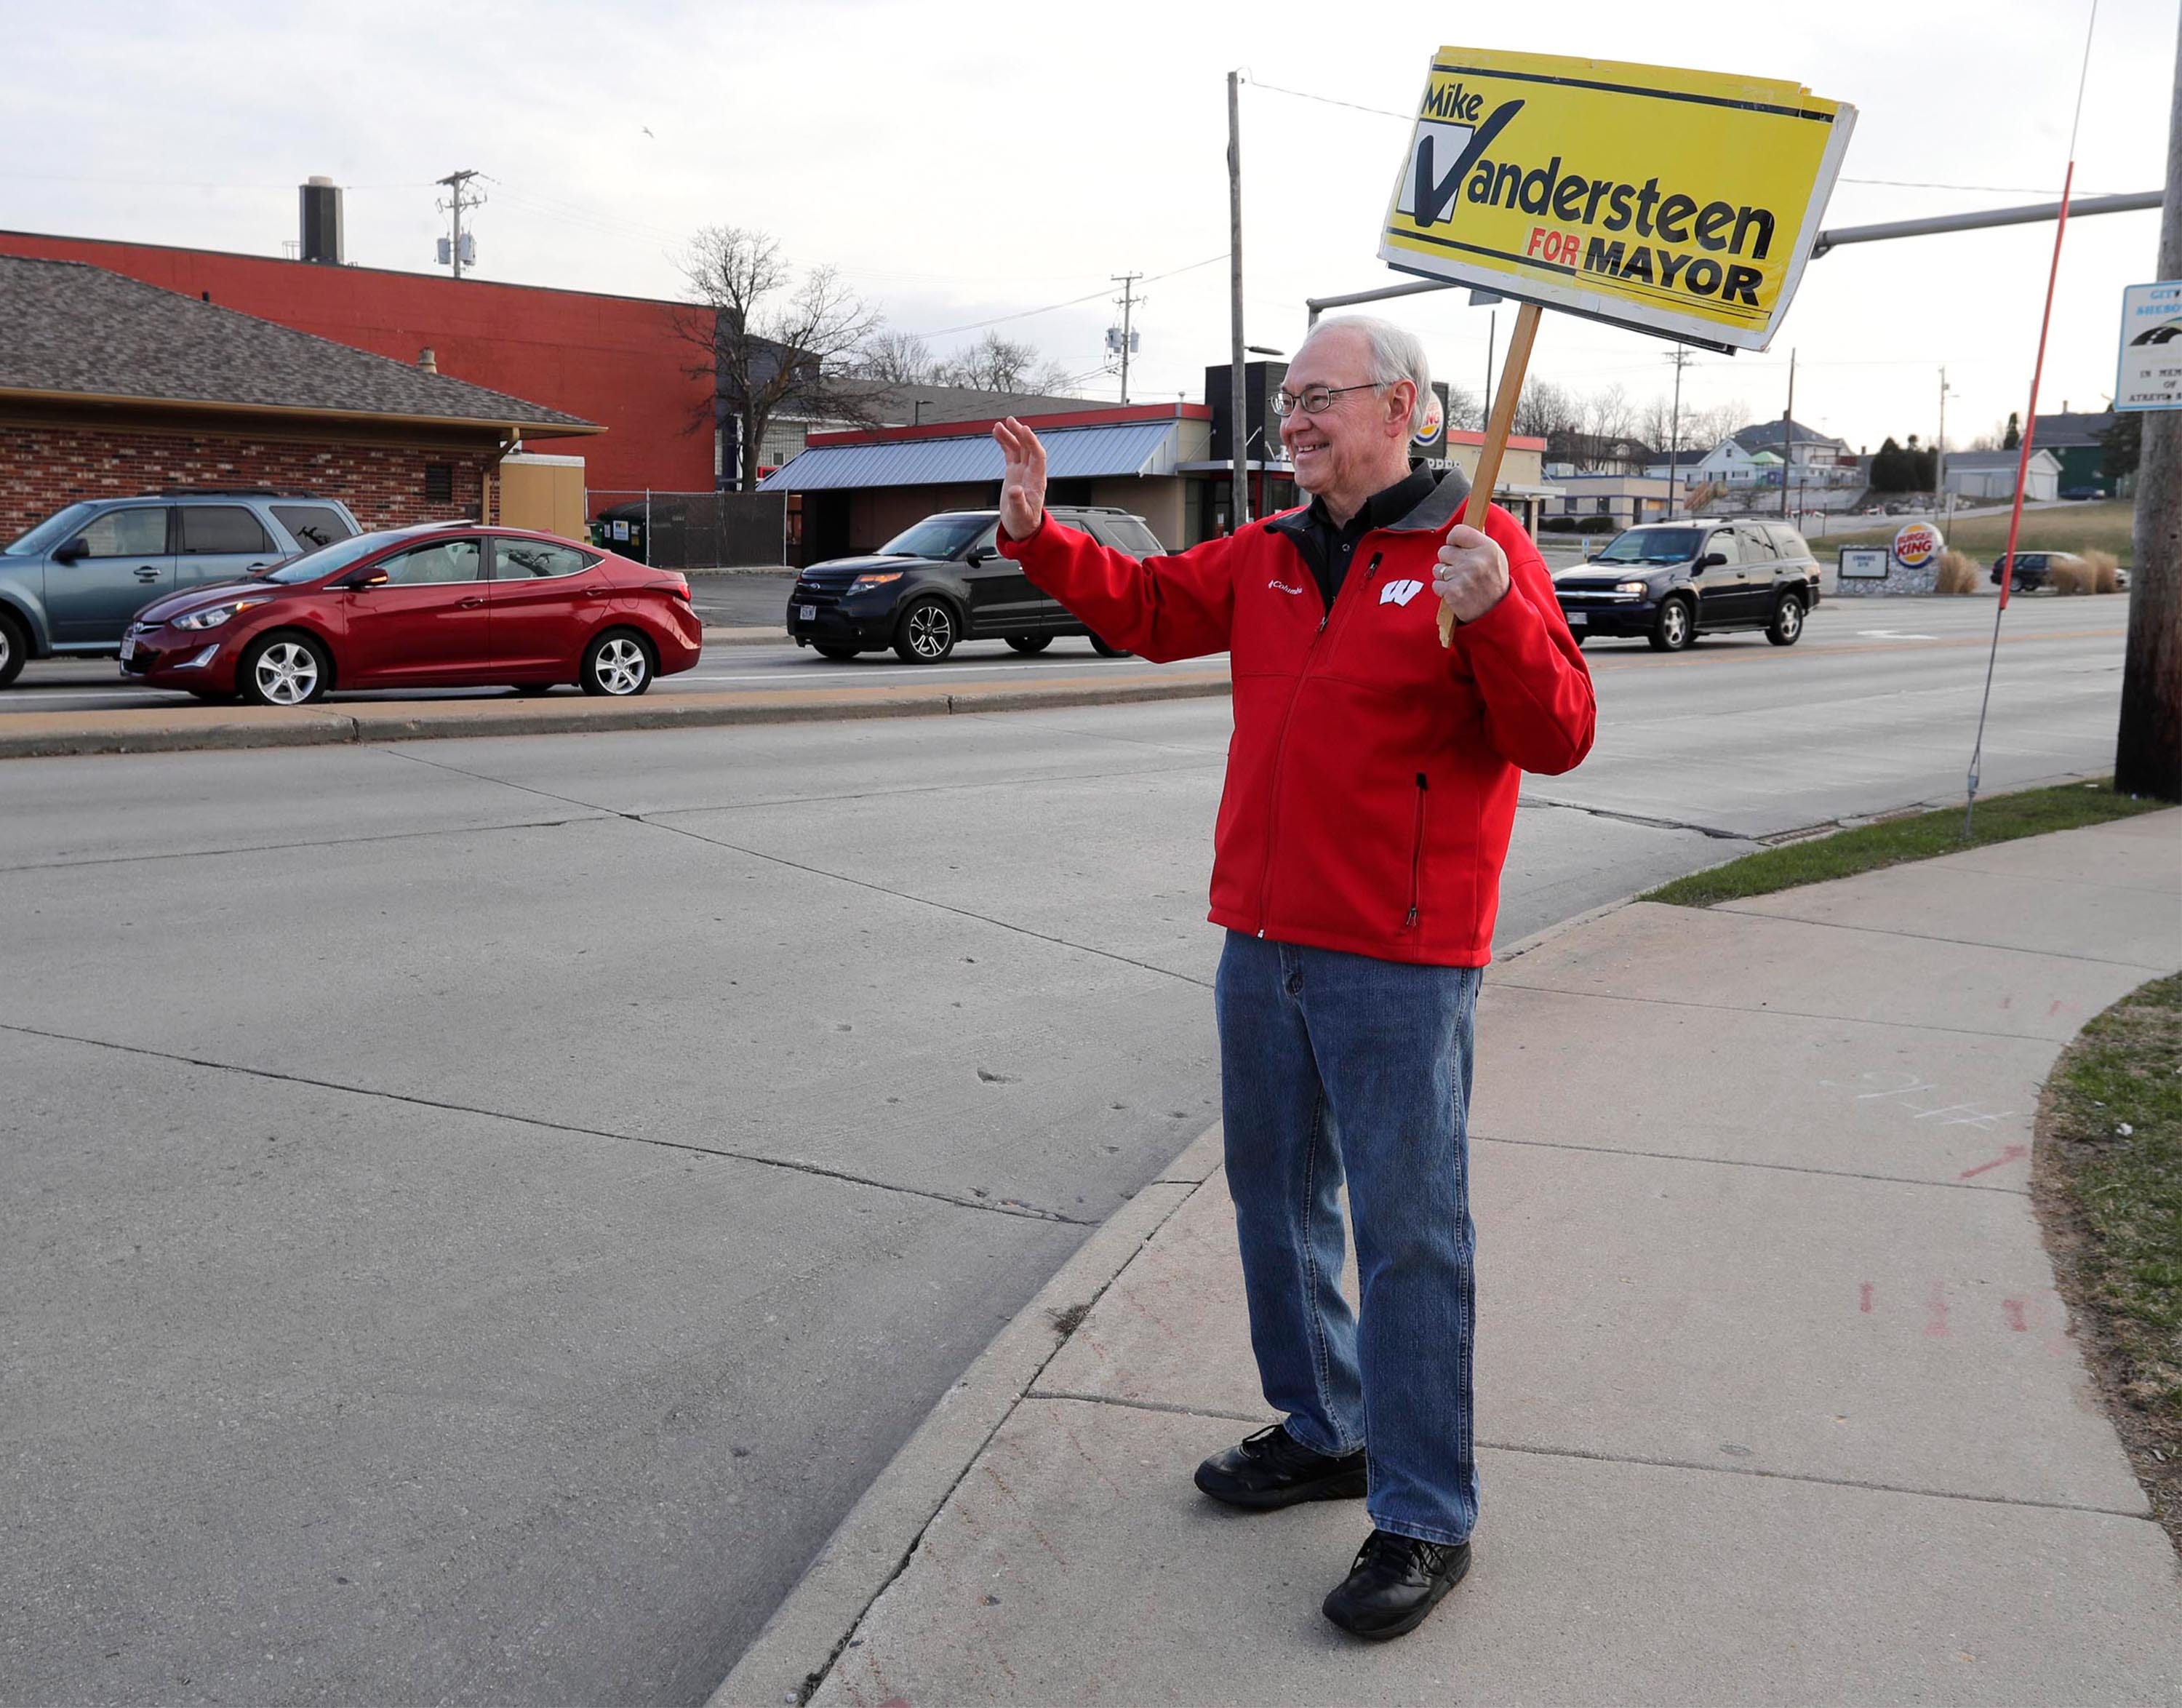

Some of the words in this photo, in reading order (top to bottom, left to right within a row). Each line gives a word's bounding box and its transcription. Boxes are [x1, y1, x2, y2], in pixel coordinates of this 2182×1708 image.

[1420, 82, 1484, 121] Mike
[1415, 99, 1775, 260] Vandersteen
[1527, 227, 1580, 266] FOR
[1583, 236, 1764, 306] MAYOR
[1896, 531, 1933, 544] BURGER
[1896, 540, 1933, 556] KING
